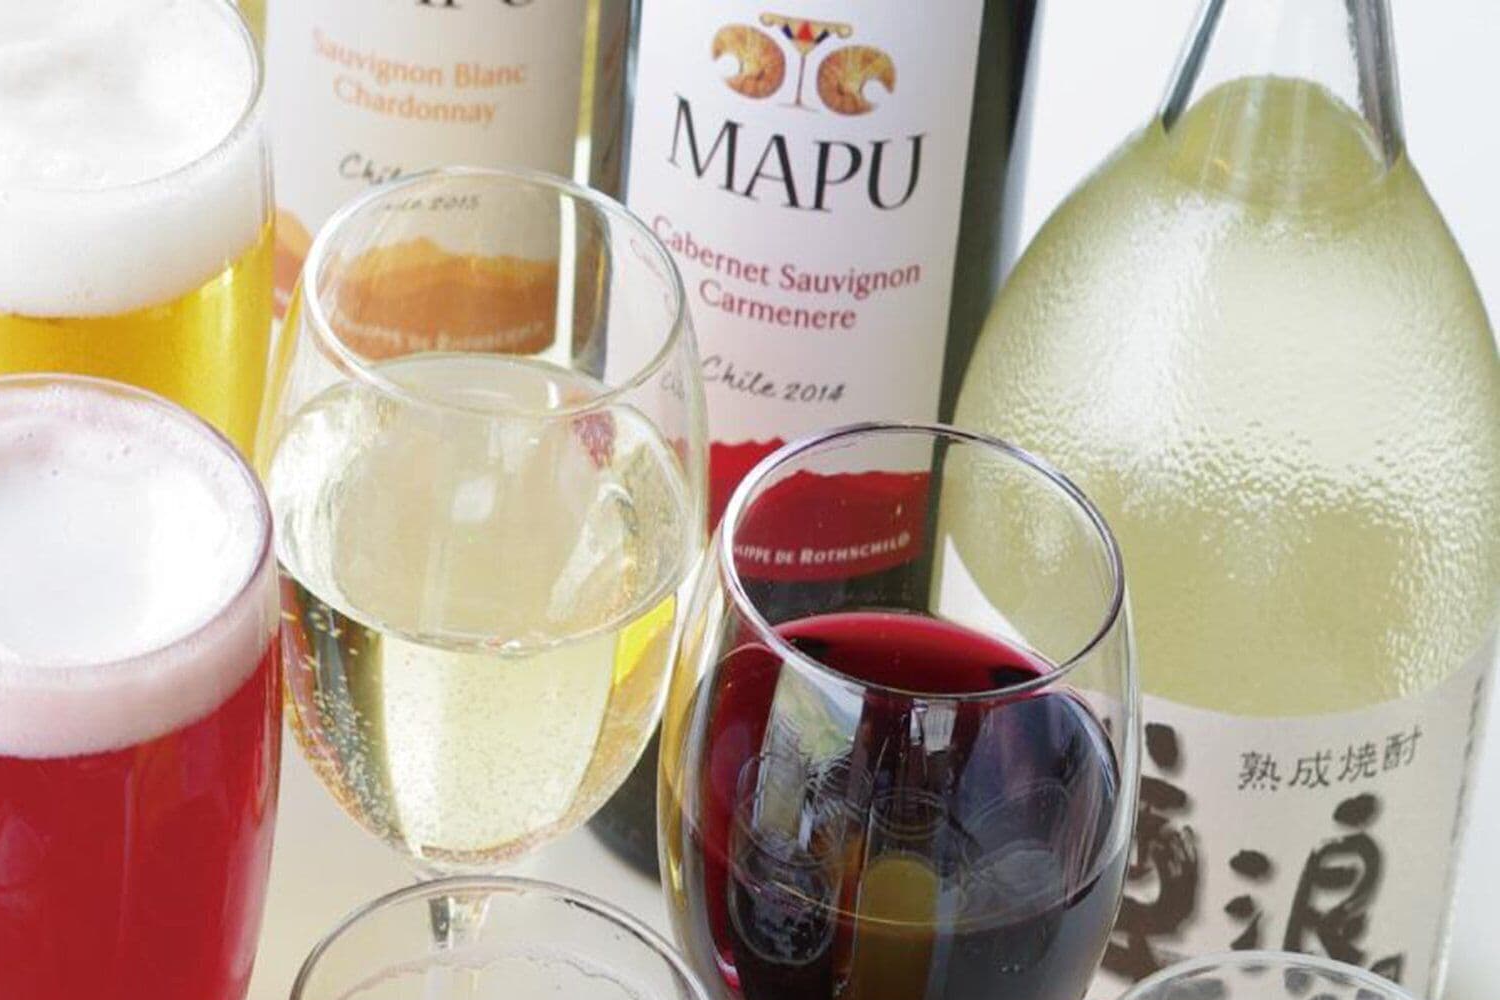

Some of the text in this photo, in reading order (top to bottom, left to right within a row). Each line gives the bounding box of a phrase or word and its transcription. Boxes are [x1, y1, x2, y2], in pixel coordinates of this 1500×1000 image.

[312, 26, 526, 90] Sauvignon Blanc
[332, 73, 497, 125] Chardonnay
[667, 92, 927, 214] MAPU
[652, 214, 921, 301] Cabernet Sauvignon
[699, 278, 857, 331] Carmenere
[701, 354, 776, 398] Chile
[1237, 724, 1423, 792] 熟成焼酎
